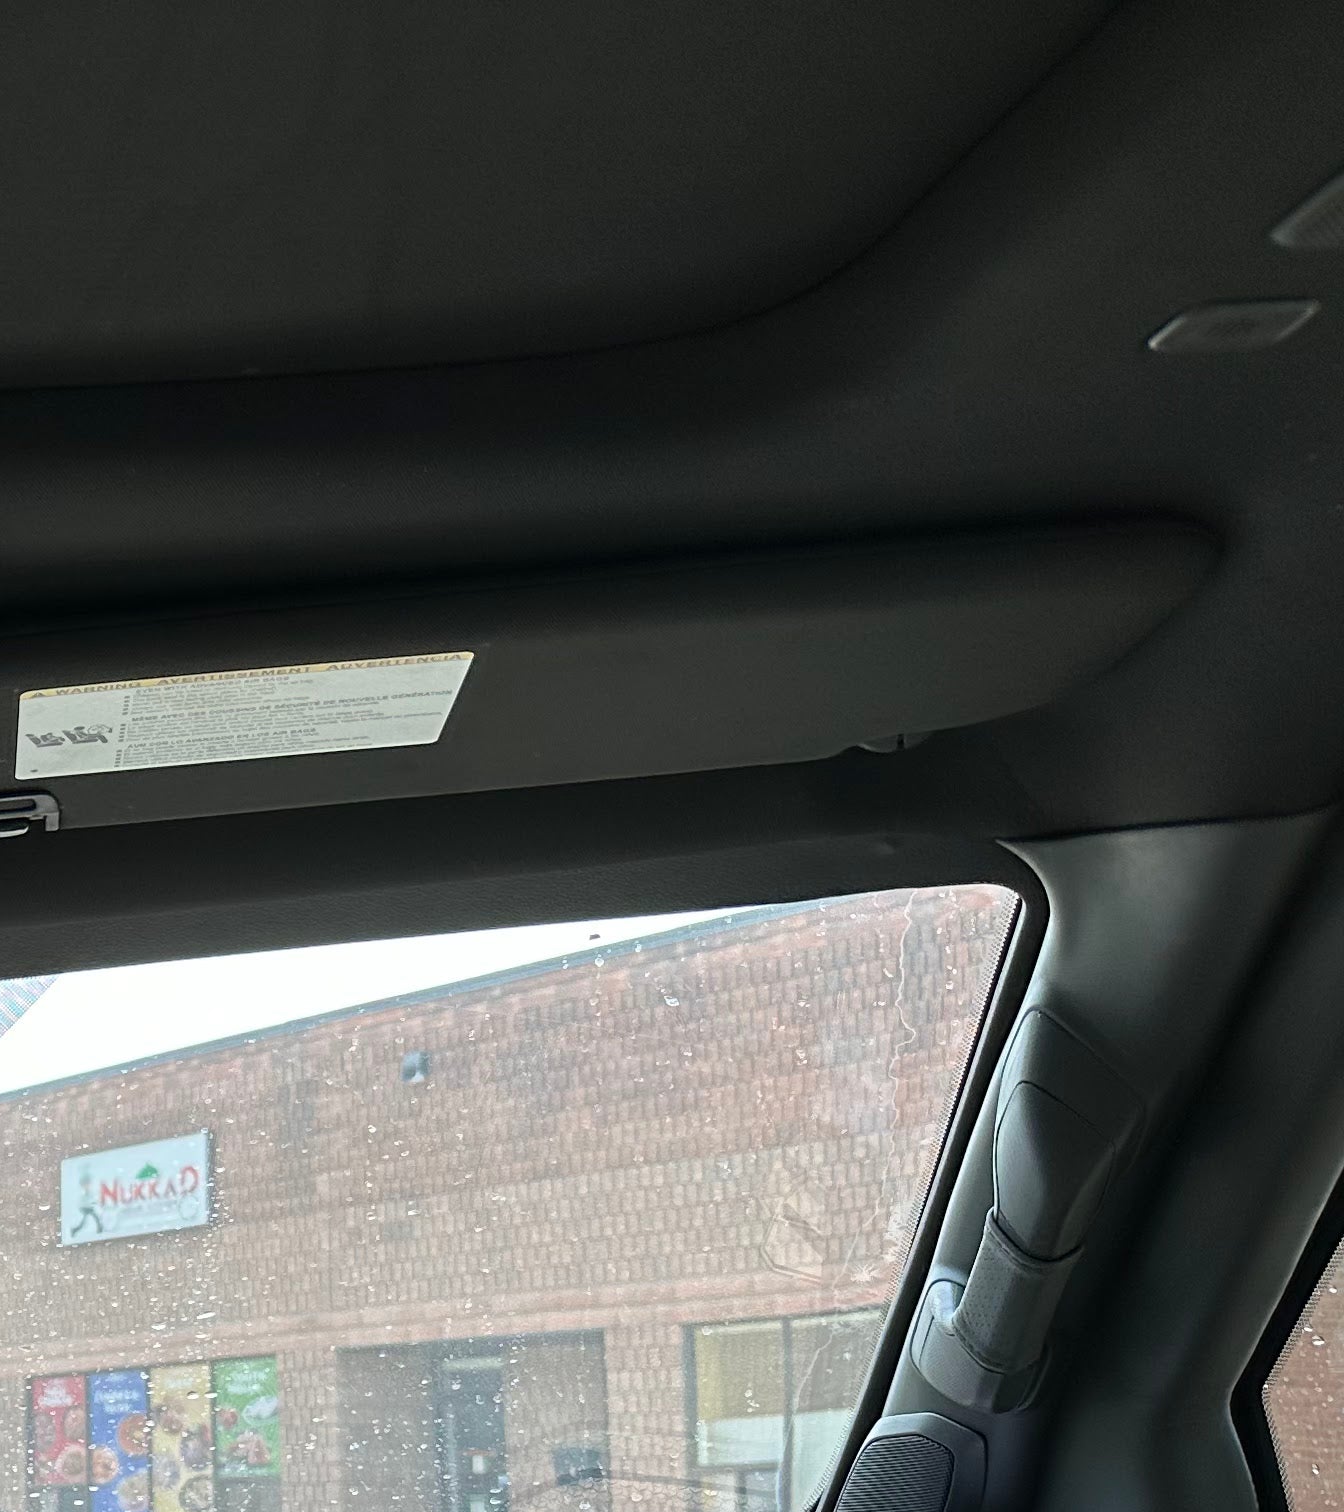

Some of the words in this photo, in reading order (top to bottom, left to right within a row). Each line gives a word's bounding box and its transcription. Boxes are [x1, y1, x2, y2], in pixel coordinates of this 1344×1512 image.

[55, 683, 141, 695] WARNING
[156, 667, 311, 686] AVERTISSEMENT
[325, 654, 463, 671] ADVERTENCIA
[100, 1165, 200, 1206] NUKKAD
